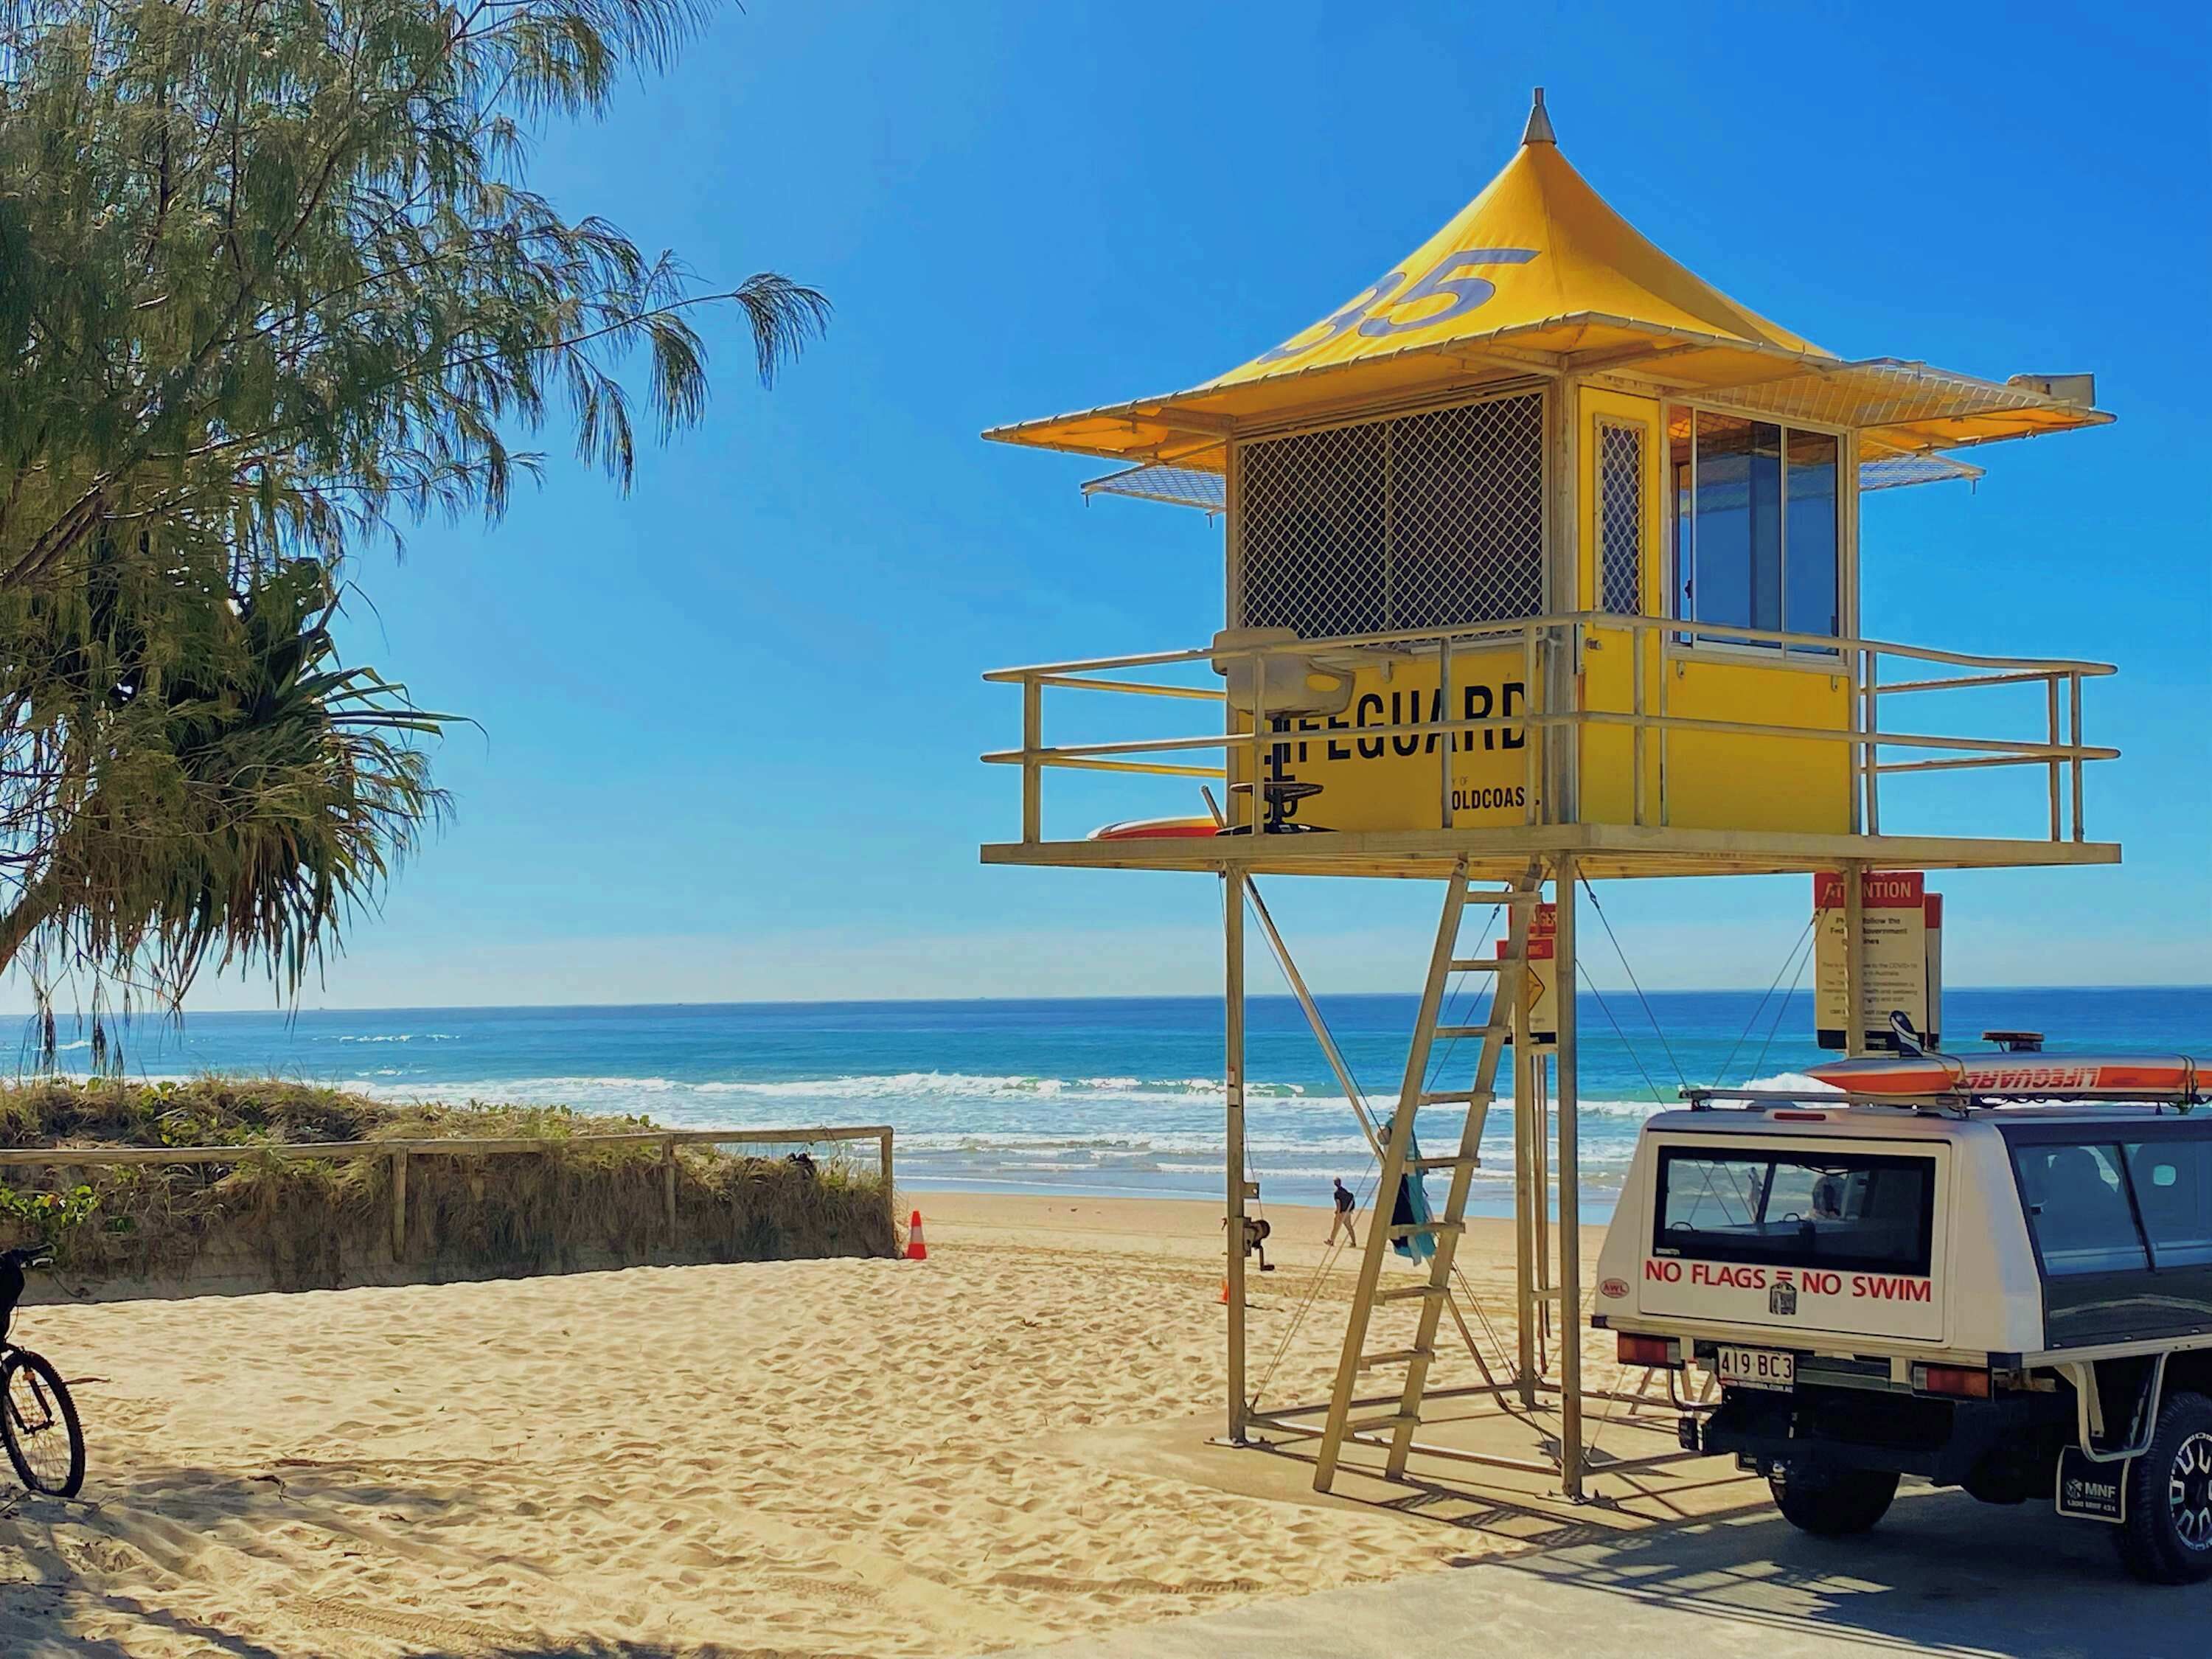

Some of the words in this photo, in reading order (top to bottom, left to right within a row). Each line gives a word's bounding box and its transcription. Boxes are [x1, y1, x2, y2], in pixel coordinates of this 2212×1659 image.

[1823, 881, 1911, 899] ATNTION
[1645, 1260, 1682, 1283] NO
[1692, 1264, 1767, 1290] FLAGS
[1802, 1271, 1842, 1295] NO
[1852, 1276, 1931, 1303] SWIM
[2084, 1481, 2116, 1498] MNF
